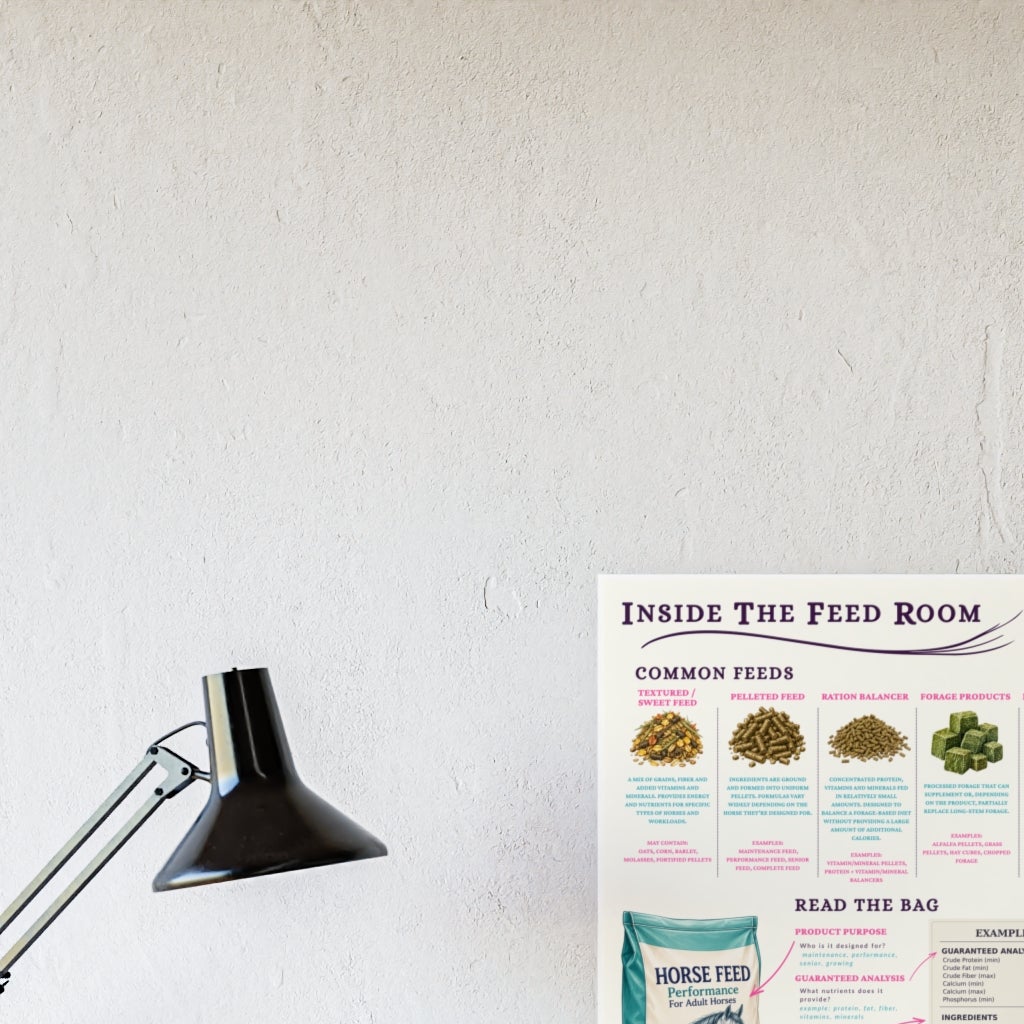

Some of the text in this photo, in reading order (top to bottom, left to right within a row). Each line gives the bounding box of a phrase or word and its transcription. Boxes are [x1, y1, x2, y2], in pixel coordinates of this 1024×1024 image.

[621, 601, 981, 626] INSIDE THE FEED ROOM
[635, 666, 794, 681] COMMON FEEDS
[637, 688, 696, 699] TEXTURED /
[730, 693, 806, 701] PELLETED FEED
[821, 693, 909, 701] RATION BALANCER
[920, 693, 1011, 701] FORAGE PRODUCTS
[638, 699, 698, 707] SWEET FEED
[795, 898, 939, 912] READ THE BAG
[795, 927, 887, 936] PRODUCT PURPOSE
[941, 947, 998, 955] GUARANTEED
[654, 964, 751, 985] HORSE FEED
[794, 974, 905, 982] GUARANTEED ANALYSIS
[978, 972, 996, 980] (max)
[968, 980, 985, 988] (min)
[668, 985, 739, 999] Performance
[669, 997, 737, 1008] For Adult Horses
[799, 996, 831, 1004] provide?
[942, 996, 978, 1004] Phosphorus
[941, 1013, 998, 1021] INGREDIENTS
